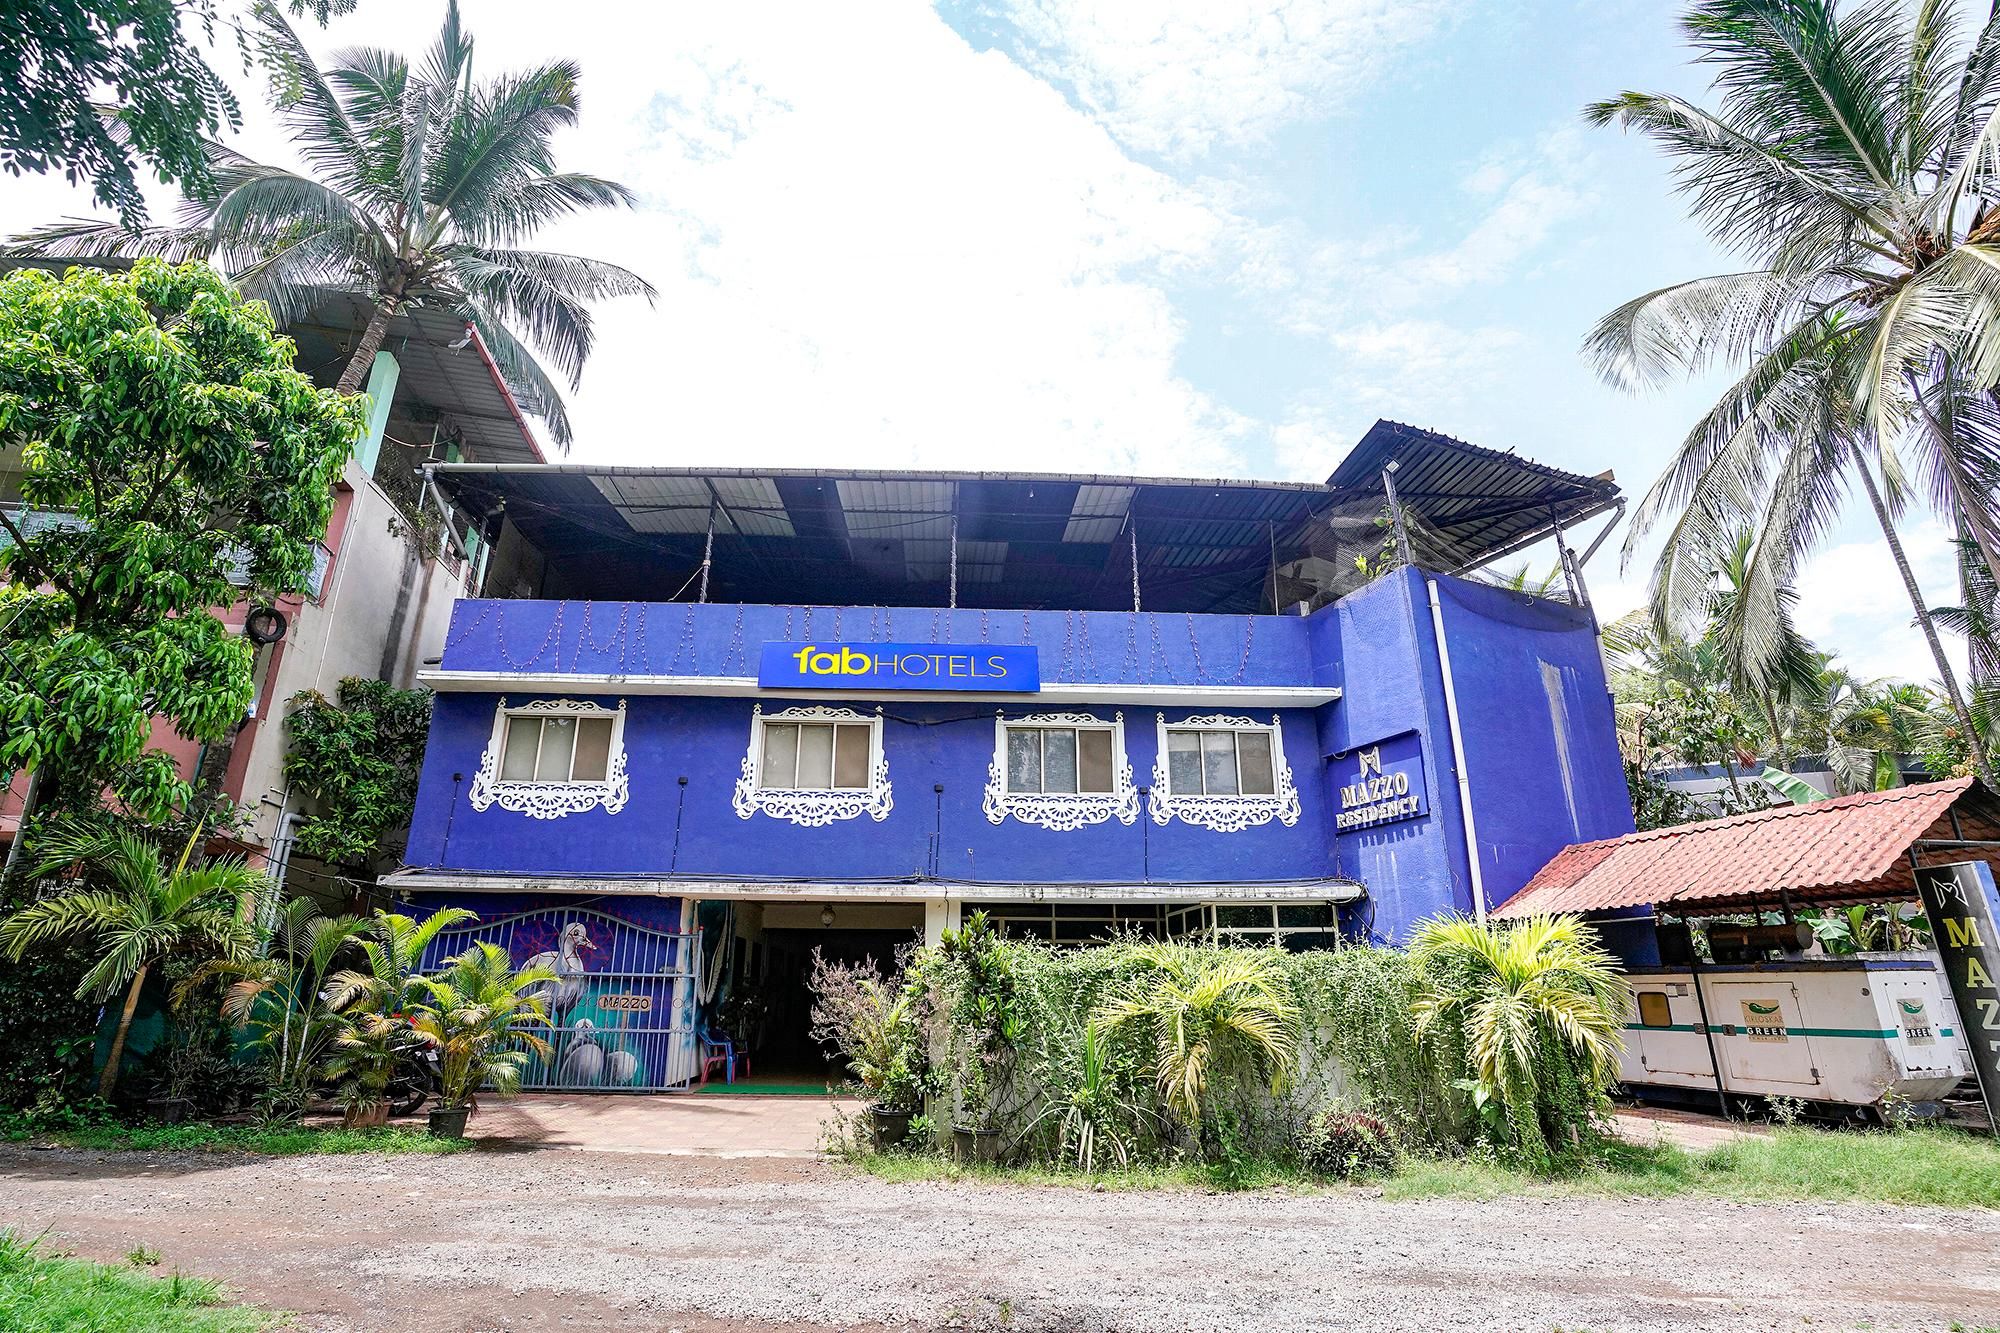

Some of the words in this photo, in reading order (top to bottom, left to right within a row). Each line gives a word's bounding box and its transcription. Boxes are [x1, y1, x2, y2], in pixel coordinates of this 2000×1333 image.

[792, 645, 1008, 678] fabHOTELS
[1340, 772, 1409, 808] MAZZO
[1336, 796, 1419, 829] RESIDENCY
[1747, 1027, 1787, 1036] GREEN
